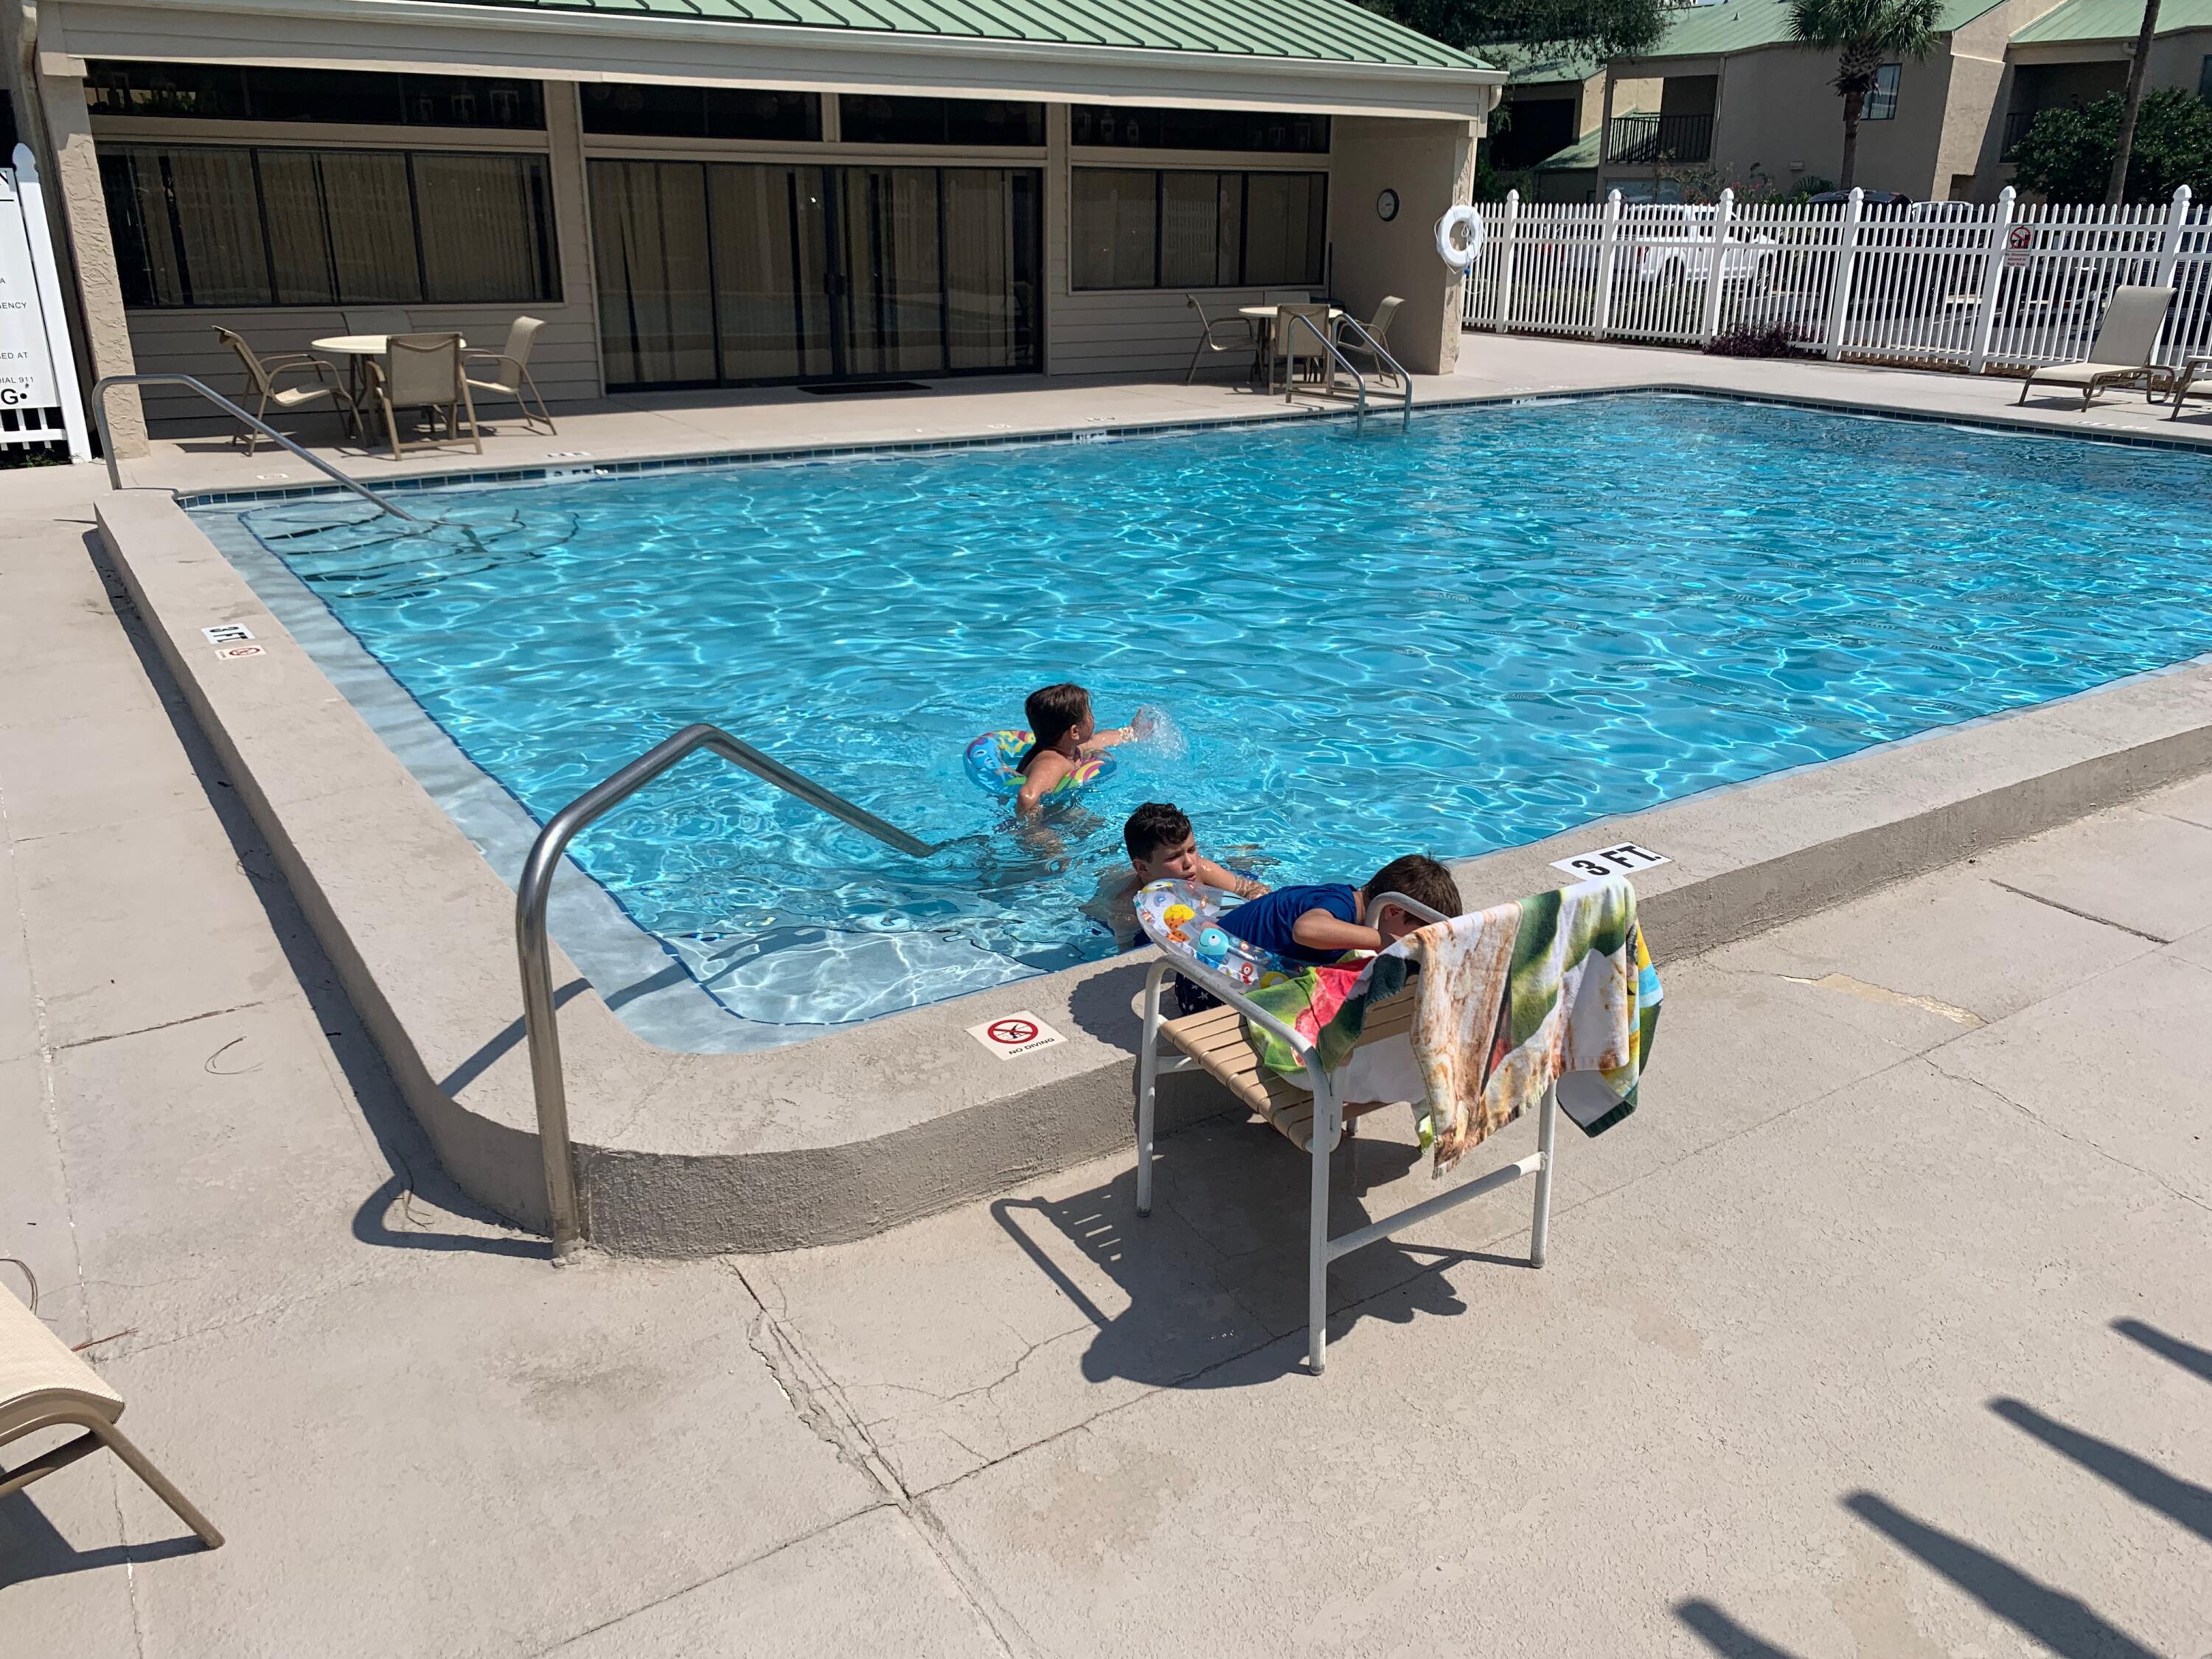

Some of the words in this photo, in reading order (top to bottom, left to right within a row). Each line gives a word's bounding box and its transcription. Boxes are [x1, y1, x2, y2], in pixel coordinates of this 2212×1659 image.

[1571, 860, 1610, 876] 3
[1599, 845, 1662, 869] FT.
[1024, 1037, 1055, 1050] DIVING
